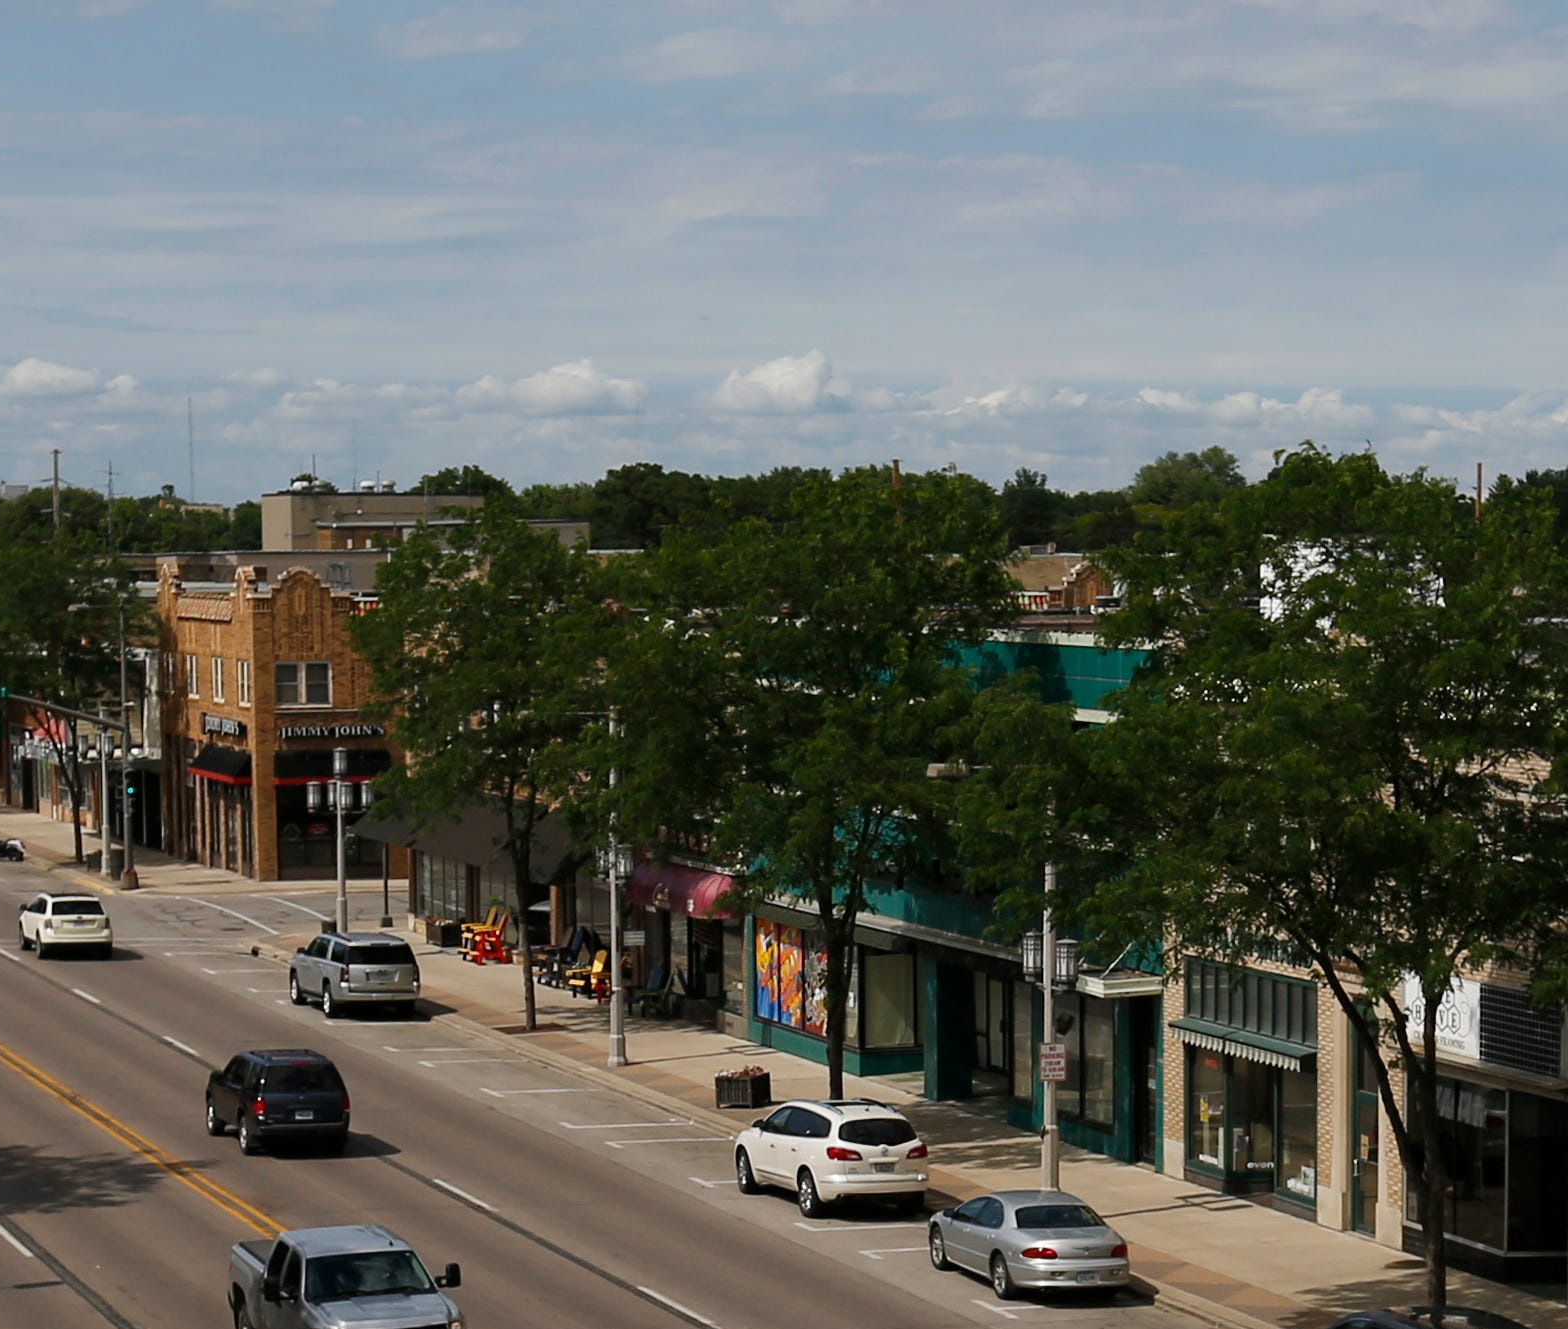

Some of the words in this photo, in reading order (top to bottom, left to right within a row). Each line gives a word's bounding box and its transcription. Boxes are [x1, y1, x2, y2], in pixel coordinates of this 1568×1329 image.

[282, 726, 330, 740] JIMMY
[335, 725, 385, 739] JOHN'S
[1415, 1005, 1457, 1029] HVE
